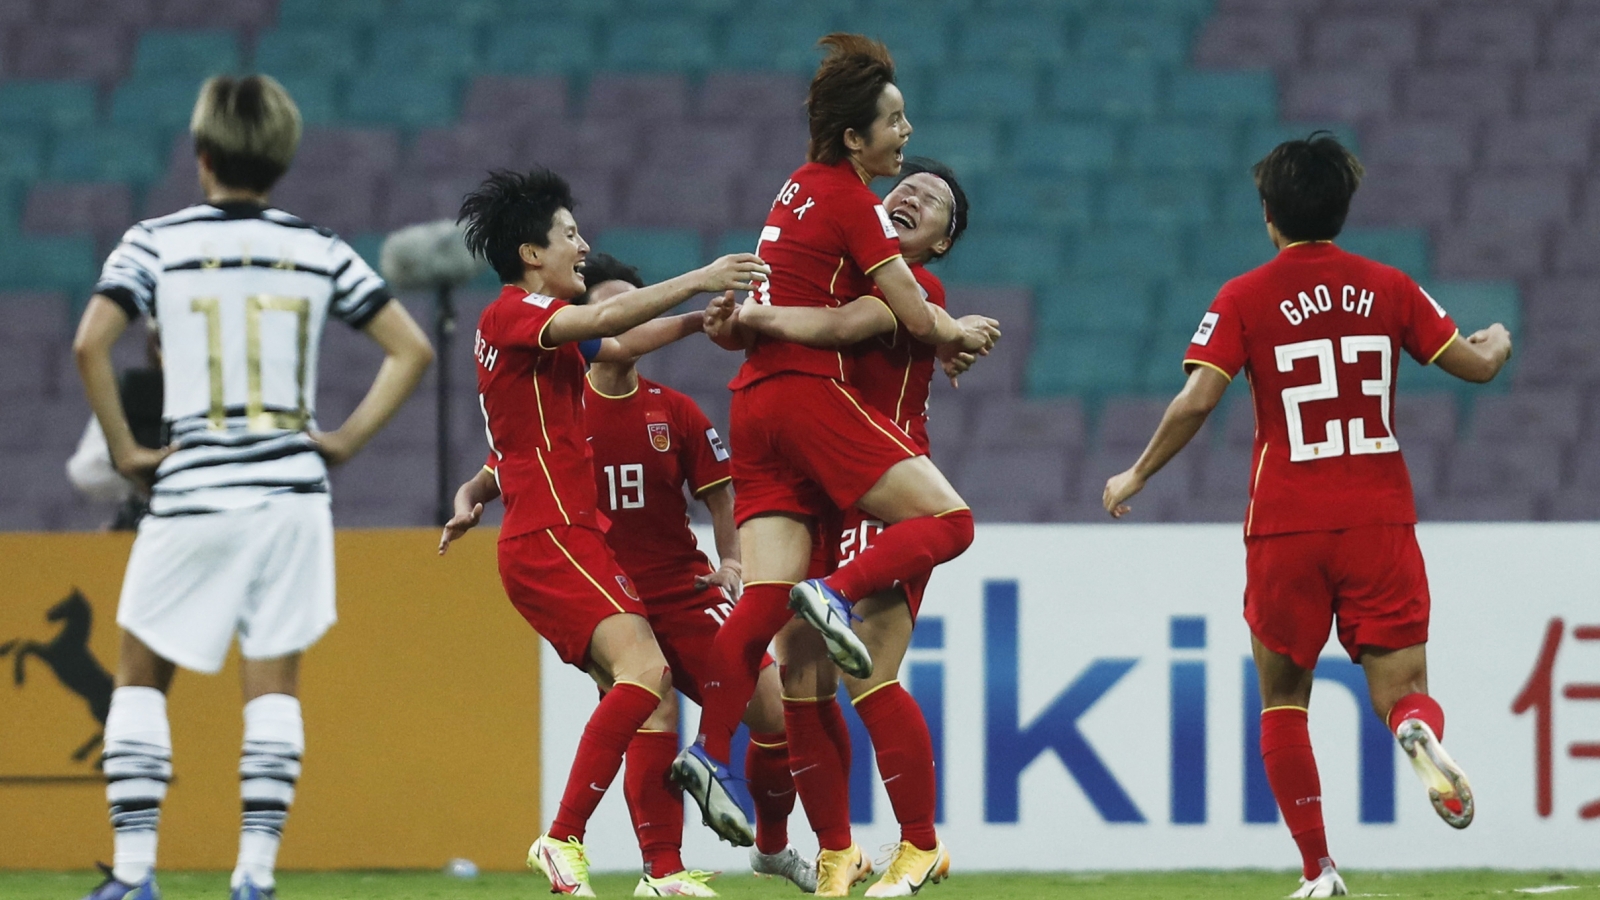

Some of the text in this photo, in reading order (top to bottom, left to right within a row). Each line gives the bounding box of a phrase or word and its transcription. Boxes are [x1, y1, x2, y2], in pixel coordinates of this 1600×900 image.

[793, 196, 815, 221] X
[1279, 284, 1375, 326] GAO CH
[190, 294, 310, 432] 10
[1274, 334, 1400, 462] 23
[603, 463, 645, 510] 19
